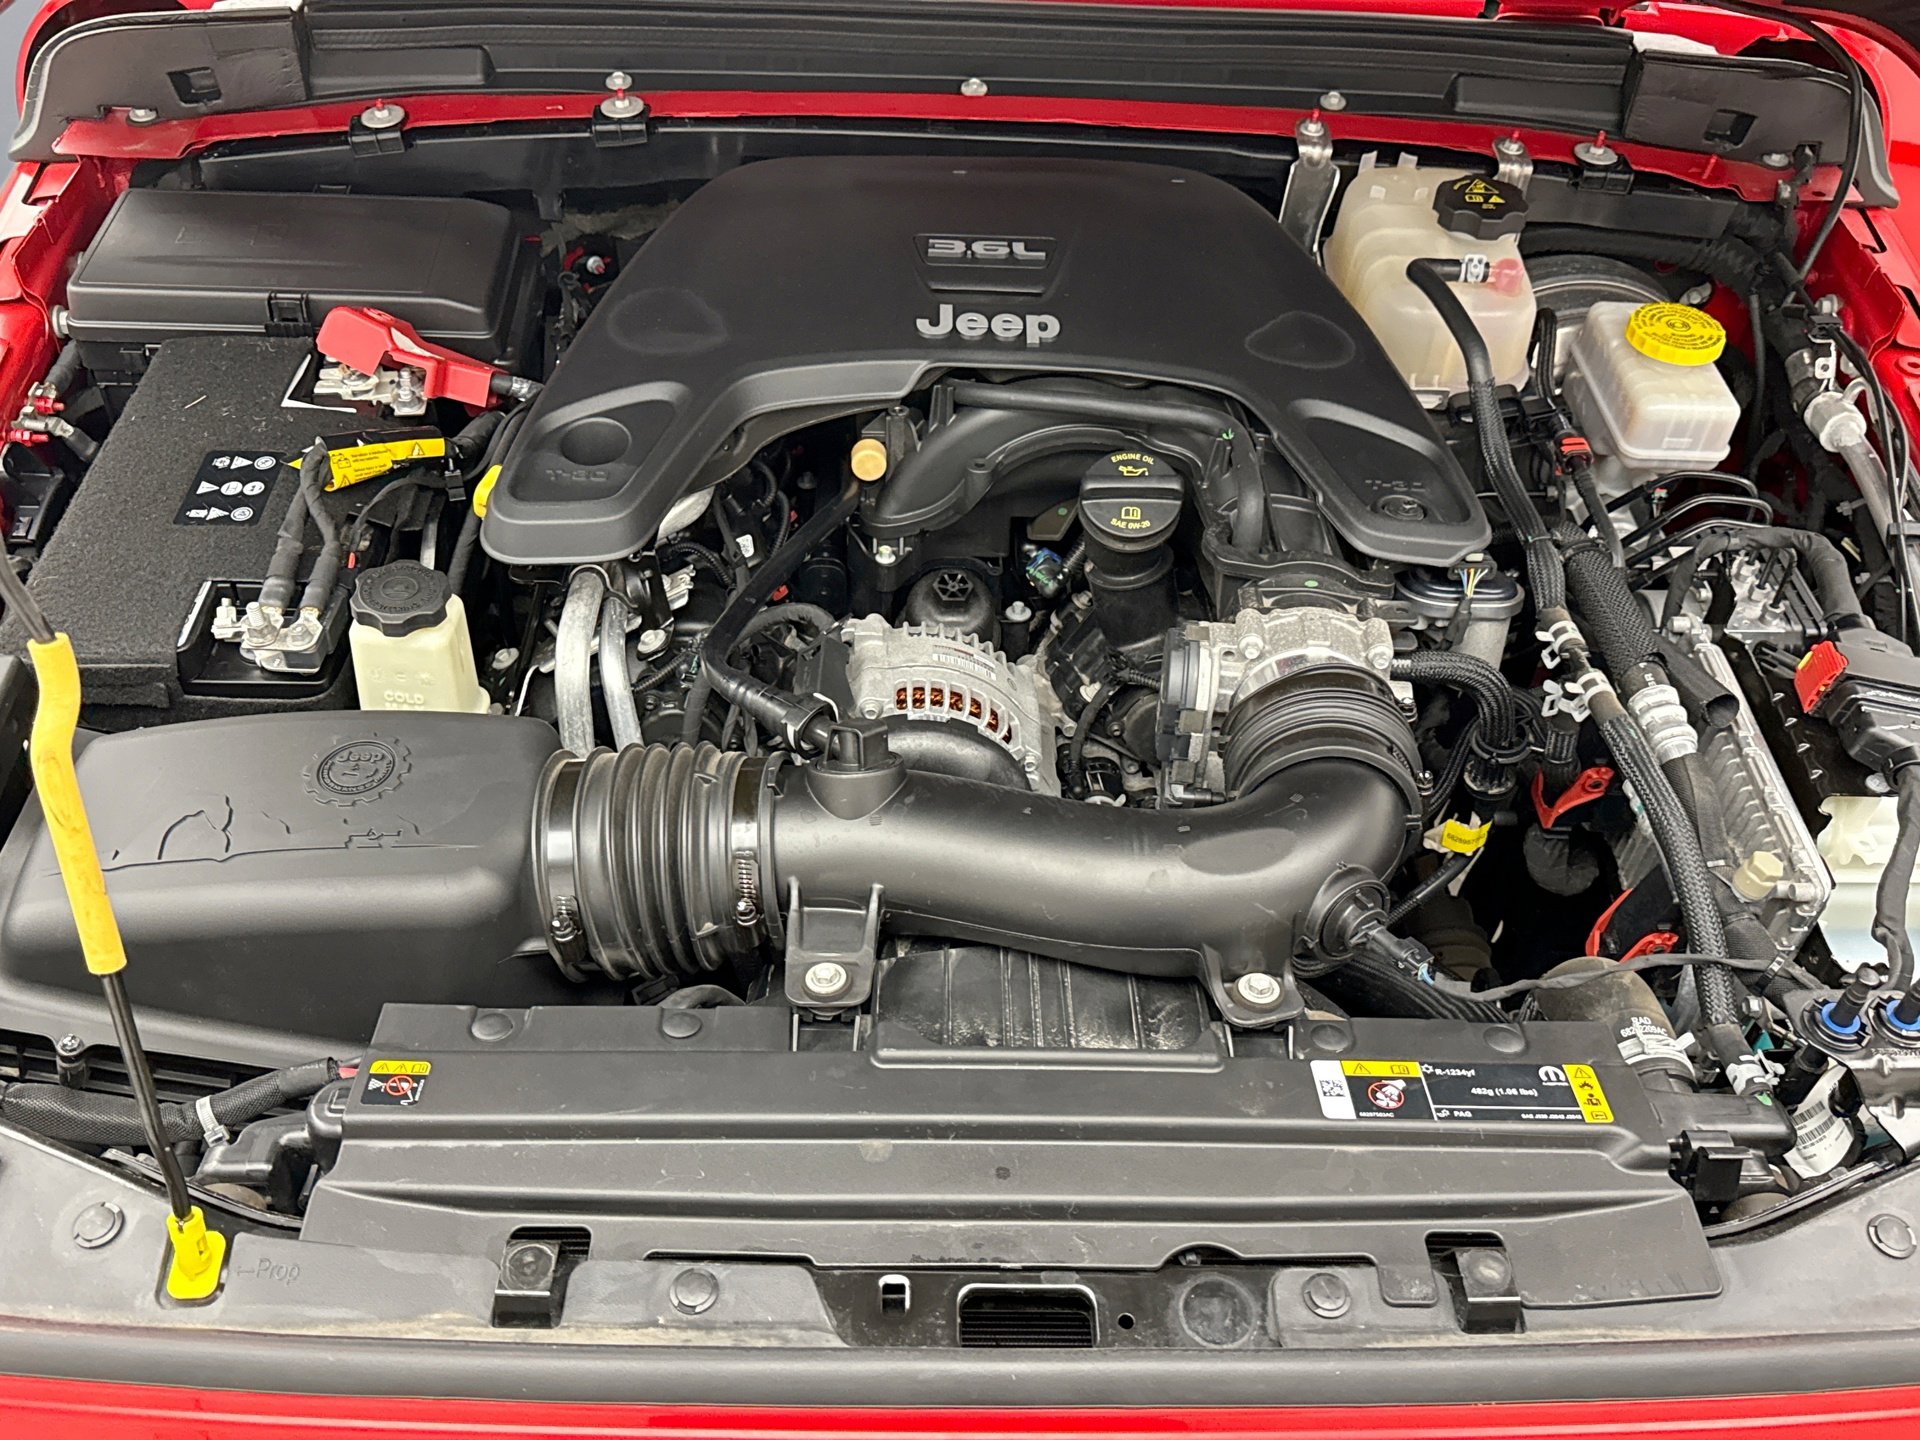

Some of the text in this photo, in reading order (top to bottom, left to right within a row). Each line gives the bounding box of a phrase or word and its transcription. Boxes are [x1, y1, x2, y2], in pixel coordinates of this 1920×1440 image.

[927, 239, 1046, 260] 3.6L
[915, 303, 1061, 347] Jeep
[1110, 453, 1154, 465] ENGINE OIL
[1110, 518, 1151, 530] SAE 0W-20
[383, 690, 425, 705] COLD
[336, 751, 385, 764] Jeep
[1631, 1016, 1652, 1025] RAD
[1434, 1068, 1476, 1078] R-1234yf
[1470, 1087, 1495, 1096] 482g
[1519, 1088, 1538, 1097] lbs)
[1453, 1110, 1473, 1118] PAG
[256, 1257, 301, 1287] Prop
